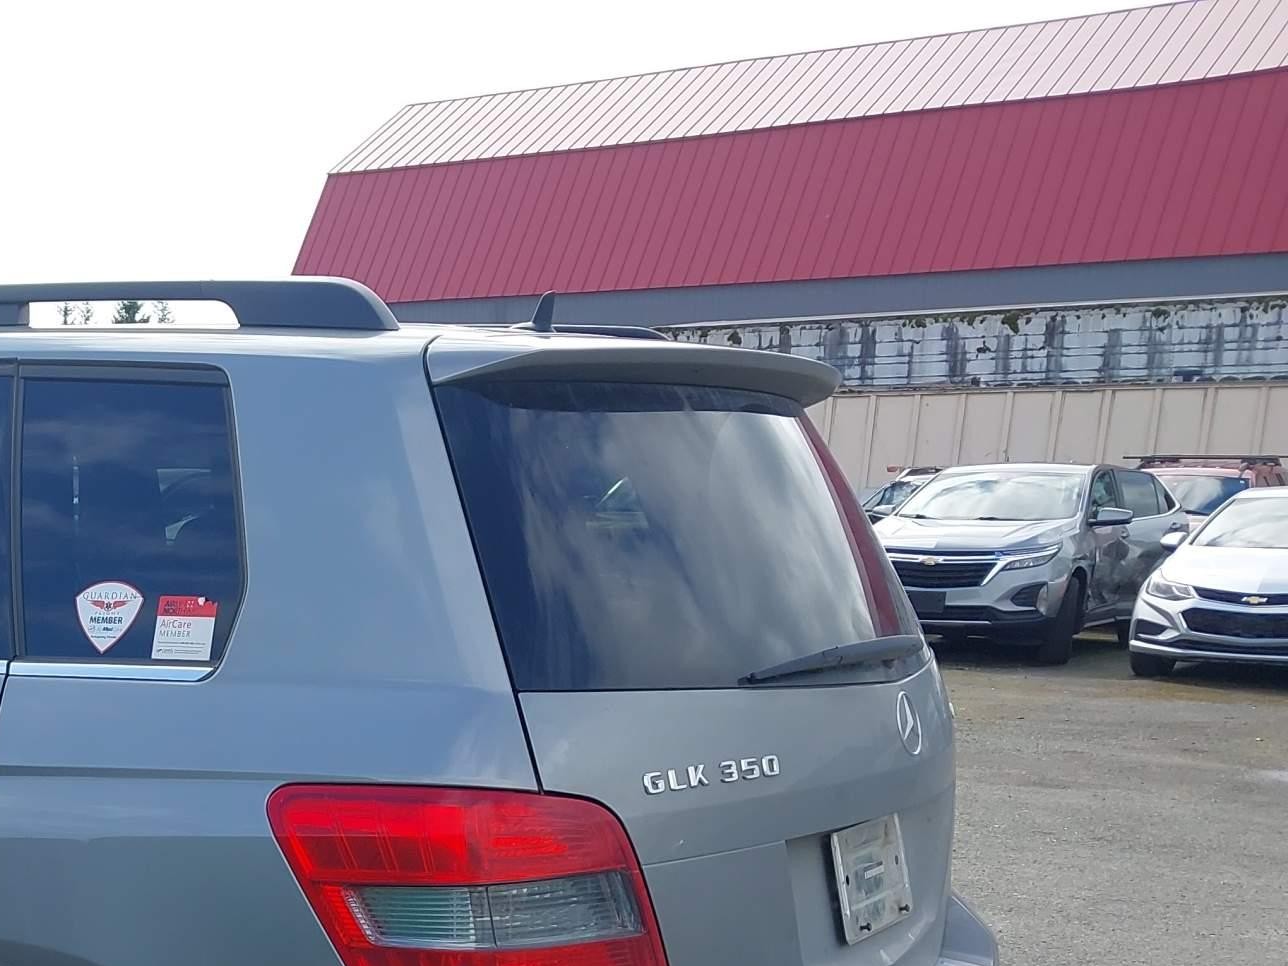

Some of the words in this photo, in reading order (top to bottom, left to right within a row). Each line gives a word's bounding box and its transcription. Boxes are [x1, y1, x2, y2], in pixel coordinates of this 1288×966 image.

[83, 591, 137, 600] GUARDIAN
[89, 616, 123, 624] MEMBER
[160, 619, 192, 629] AirCare
[159, 630, 191, 638] MEMBER
[643, 764, 710, 795] GLK
[719, 754, 780, 784] 350
